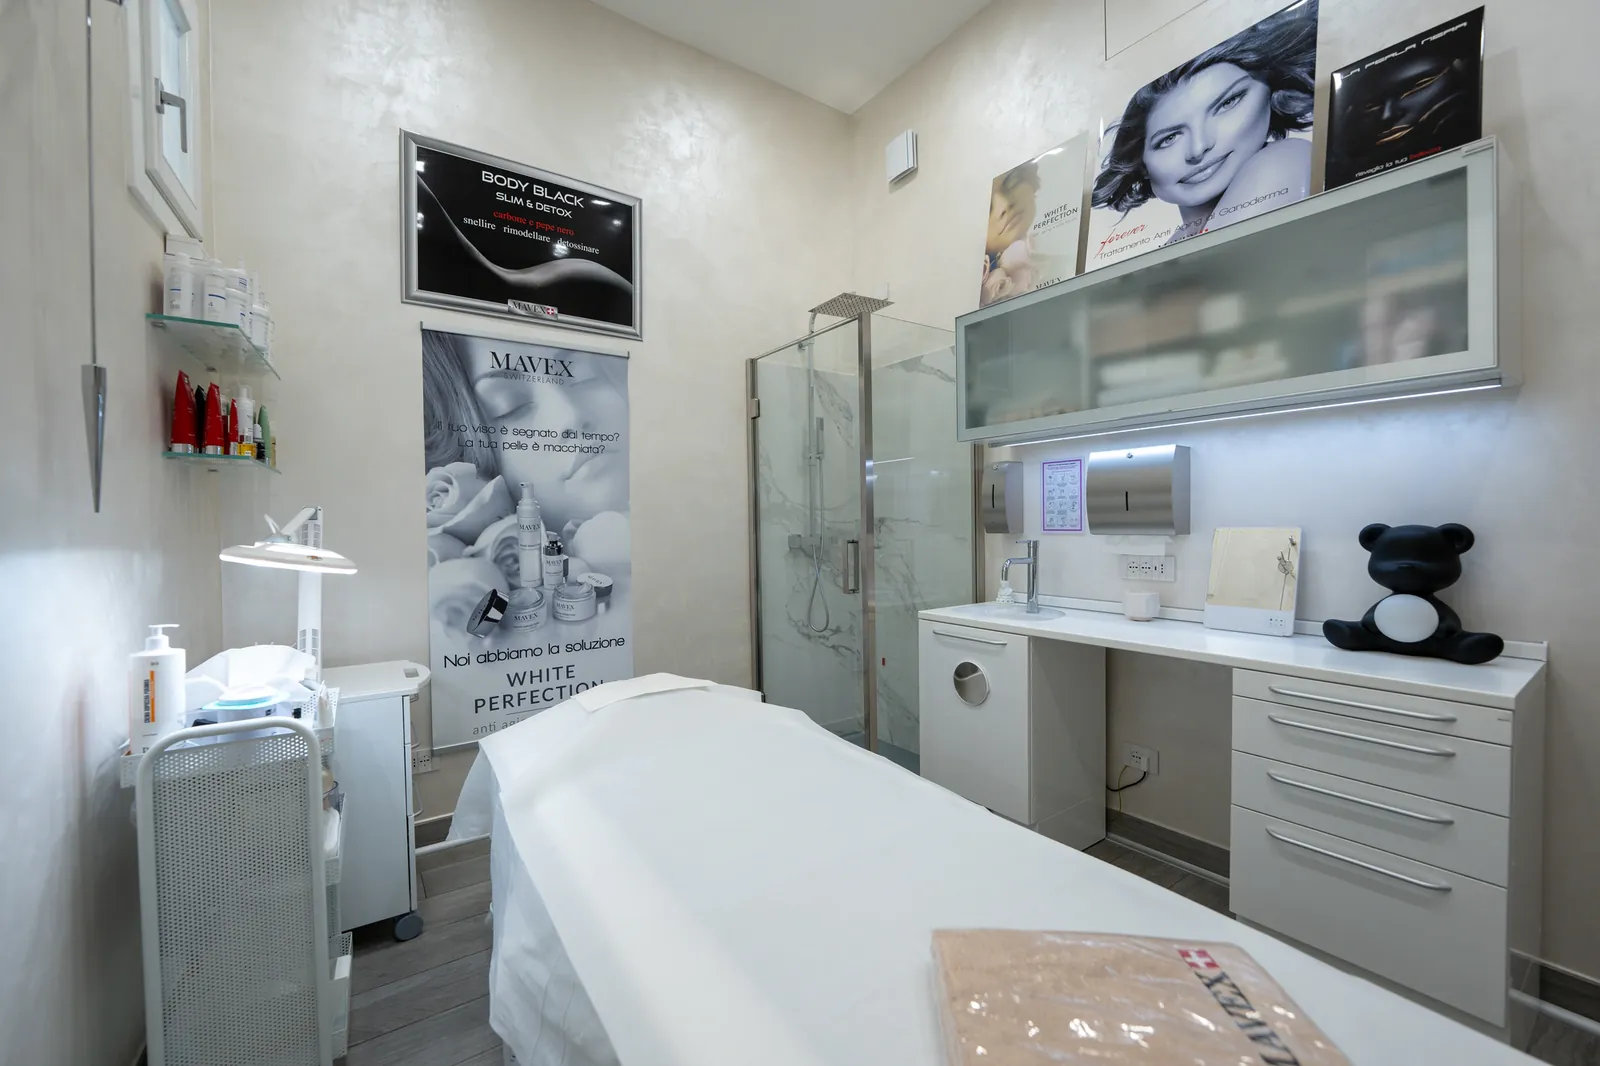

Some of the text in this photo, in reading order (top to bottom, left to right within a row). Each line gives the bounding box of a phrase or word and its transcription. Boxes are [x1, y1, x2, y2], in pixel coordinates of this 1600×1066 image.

[481, 170, 584, 208] BODY BLACK
[495, 191, 573, 219] SLIM & DETOX
[1044, 203, 1068, 219] WHITE
[493, 210, 527, 225] carbone
[535, 220, 555, 232] pepe
[557, 226, 575, 236] nero
[1033, 207, 1078, 231] PERFECTION
[1100, 237, 1151, 259] Trattamento
[1153, 228, 1172, 241] Anti
[1175, 218, 1203, 231] Aging
[1218, 187, 1289, 216] Ganoderma
[463, 216, 600, 254] snellire rimodellare detossinare
[1094, 223, 1147, 259] forever
[512, 300, 546, 315] MAVEX
[489, 350, 575, 378] MAVEX
[503, 372, 565, 386] SWITZERLAND
[448, 422, 468, 433] tuo
[472, 423, 496, 434] viso
[500, 425, 508, 435] è
[512, 428, 558, 439] segnato
[561, 429, 578, 440] dal
[582, 431, 620, 443] tempo?
[457, 437, 606, 454] La tua pelle è macchiata?
[443, 636, 625, 668] Noi abbiamo la soluzione
[506, 664, 576, 688] WHITE
[472, 721, 497, 736] anti
